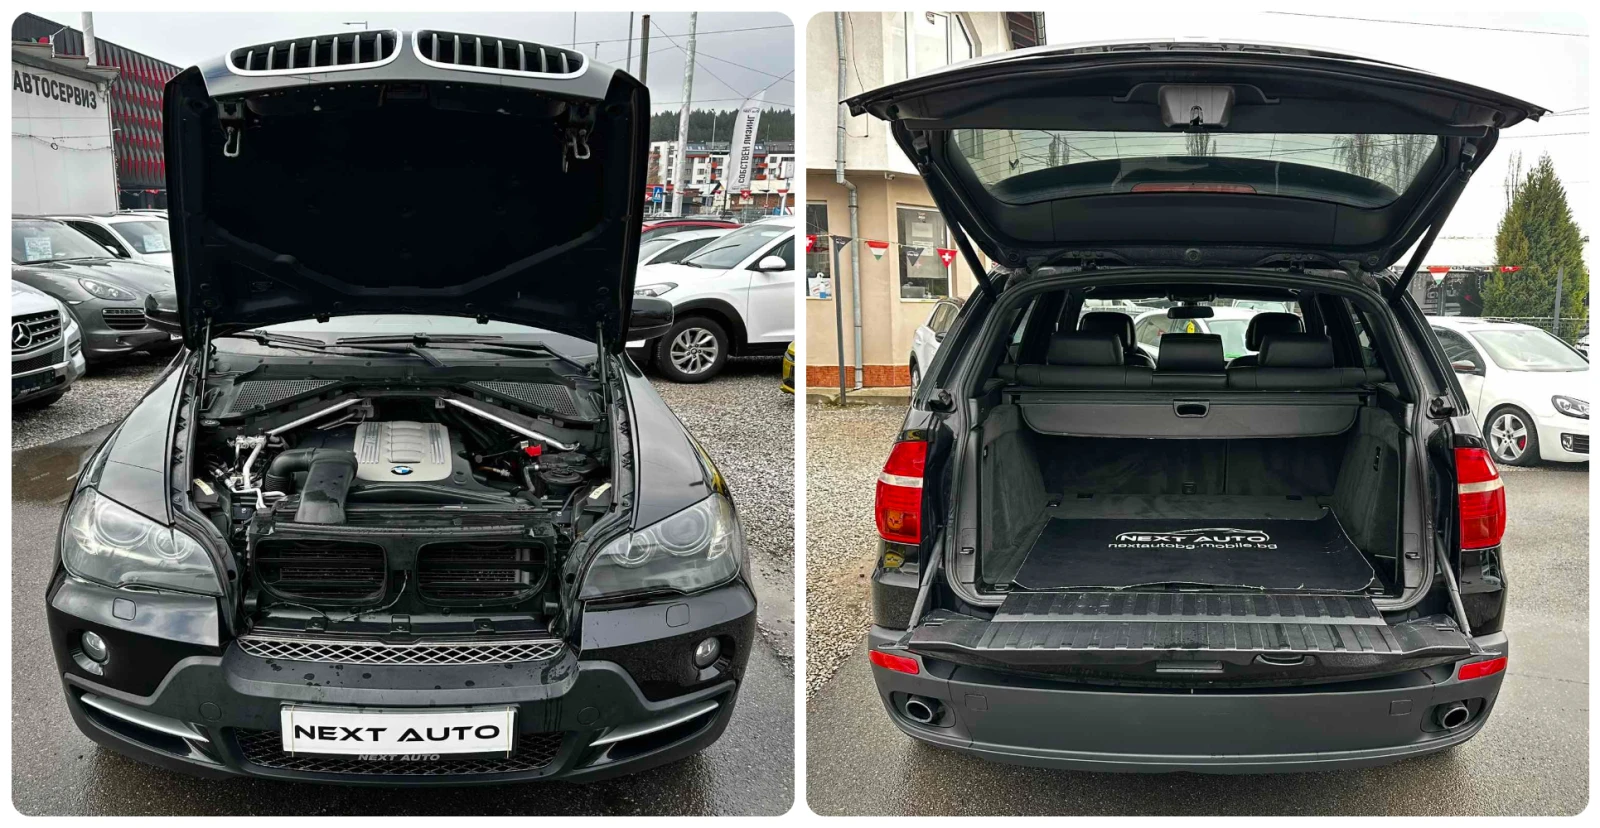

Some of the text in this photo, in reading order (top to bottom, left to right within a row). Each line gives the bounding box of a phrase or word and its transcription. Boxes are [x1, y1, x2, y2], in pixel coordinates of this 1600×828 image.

[13, 70, 97, 110] АВТОСЕРВИЗ
[743, 114, 756, 145] ЛИЗИНГ
[738, 146, 751, 184] СОБСТВЕН
[1120, 535, 1267, 543] NEXT AUTO
[294, 724, 501, 742] NEXT AUTO
[357, 753, 441, 762] NEXT AUTO
